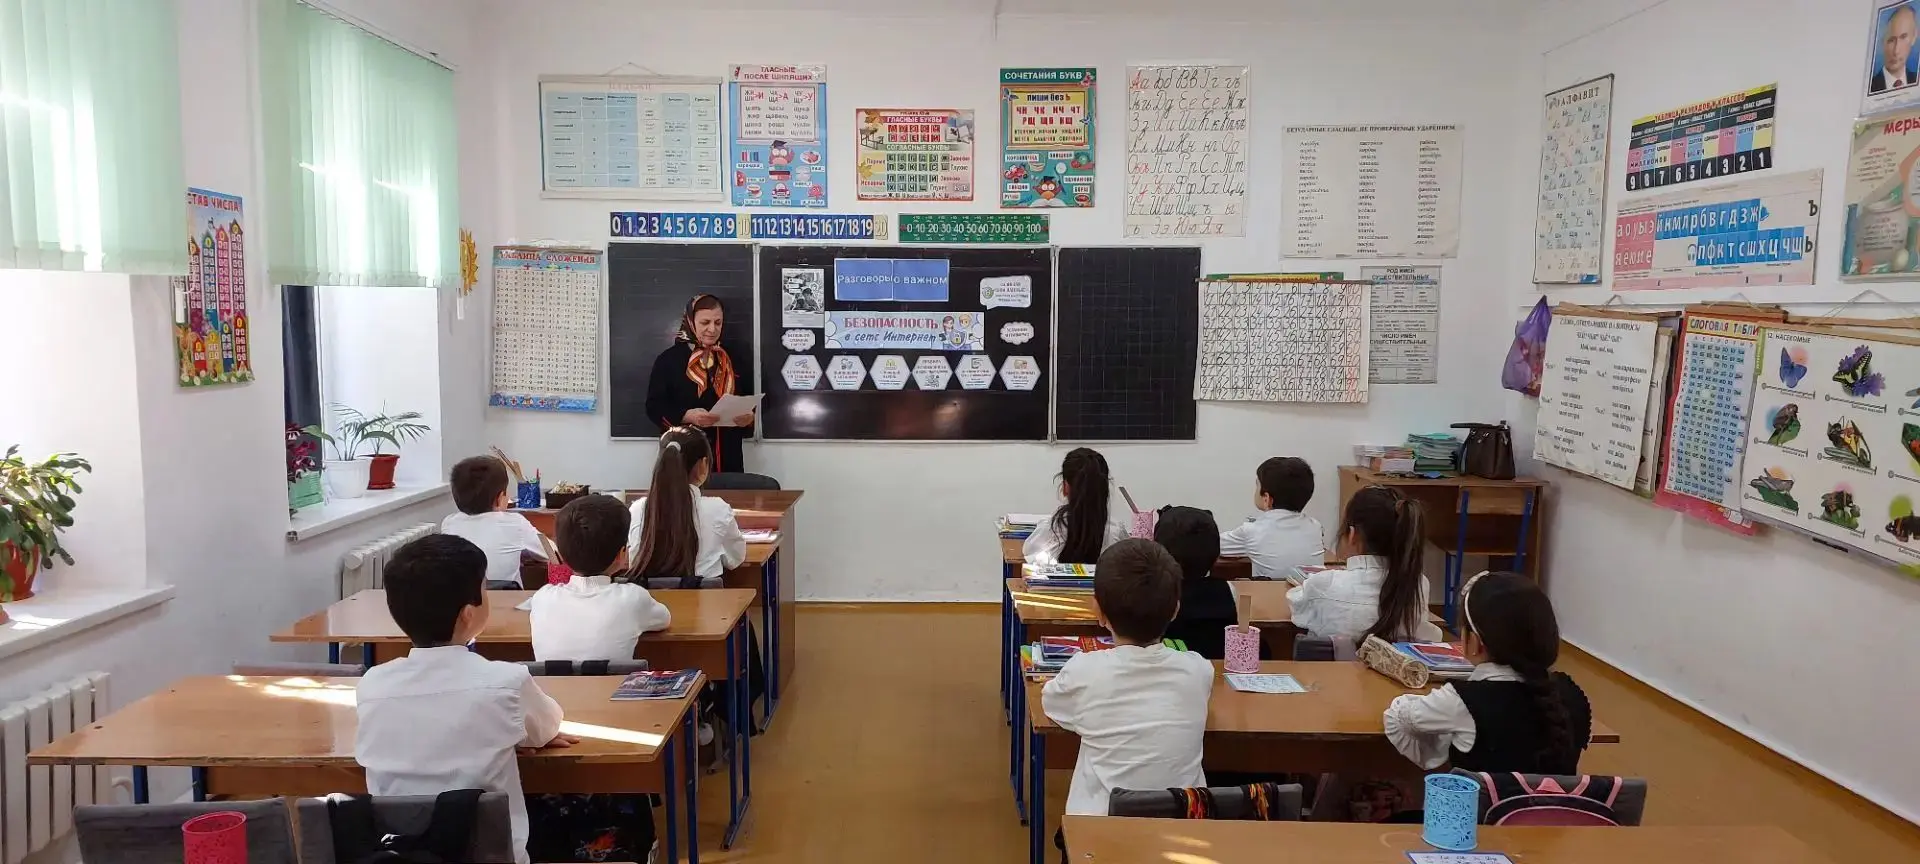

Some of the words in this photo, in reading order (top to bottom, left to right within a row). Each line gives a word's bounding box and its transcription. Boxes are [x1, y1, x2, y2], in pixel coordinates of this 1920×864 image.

[1630, 175, 1636, 189] 9
[1644, 173, 1650, 187] 8
[1659, 171, 1664, 184] 7
[1676, 168, 1681, 182] 6
[1690, 165, 1695, 179] 5
[1705, 162, 1712, 177] 4
[1722, 158, 1729, 173] 3
[1739, 155, 1746, 171] 2
[1759, 152, 1765, 167] 1
[211, 196, 240, 212] ЧИСЛА
[612, 216, 620, 234] 0
[626, 216, 632, 234] 1
[639, 217, 647, 234] 2
[651, 217, 659, 234] 3
[664, 217, 672, 234] 4
[676, 217, 684, 234] 5
[688, 217, 698, 234] 6
[701, 218, 709, 235] 7
[714, 218, 723, 235] 8
[726, 218, 735, 235] 9
[739, 218, 750, 235] 10
[752, 218, 763, 235] 11
[765, 218, 777, 235] 12
[780, 218, 791, 235] 13
[793, 219, 805, 236] 14
[807, 219, 819, 236] 15
[821, 219, 832, 236] 16
[834, 219, 846, 236] 17
[848, 219, 860, 236] 18
[861, 219, 873, 236] 19
[875, 219, 887, 236] 20
[907, 223, 912, 234] 0
[916, 223, 925, 234] 10
[928, 223, 938, 234] 20
[941, 223, 951, 234] 30
[954, 223, 964, 234] 40
[966, 223, 976, 234] 50
[978, 223, 989, 234] 60
[991, 223, 1001, 234] 70
[1002, 223, 1013, 234] 80
[1014, 223, 1024, 234] 90
[1027, 223, 1041, 234] 100
[837, 274, 892, 284] Разговоры
[844, 318, 939, 329] БЕЗОПАСНОСТЬ
[1691, 319, 1729, 332] СЛОГОВАЯ
[883, 332, 936, 343] Интернет
[1776, 334, 1811, 343] НАСЕКОМЫЕ
